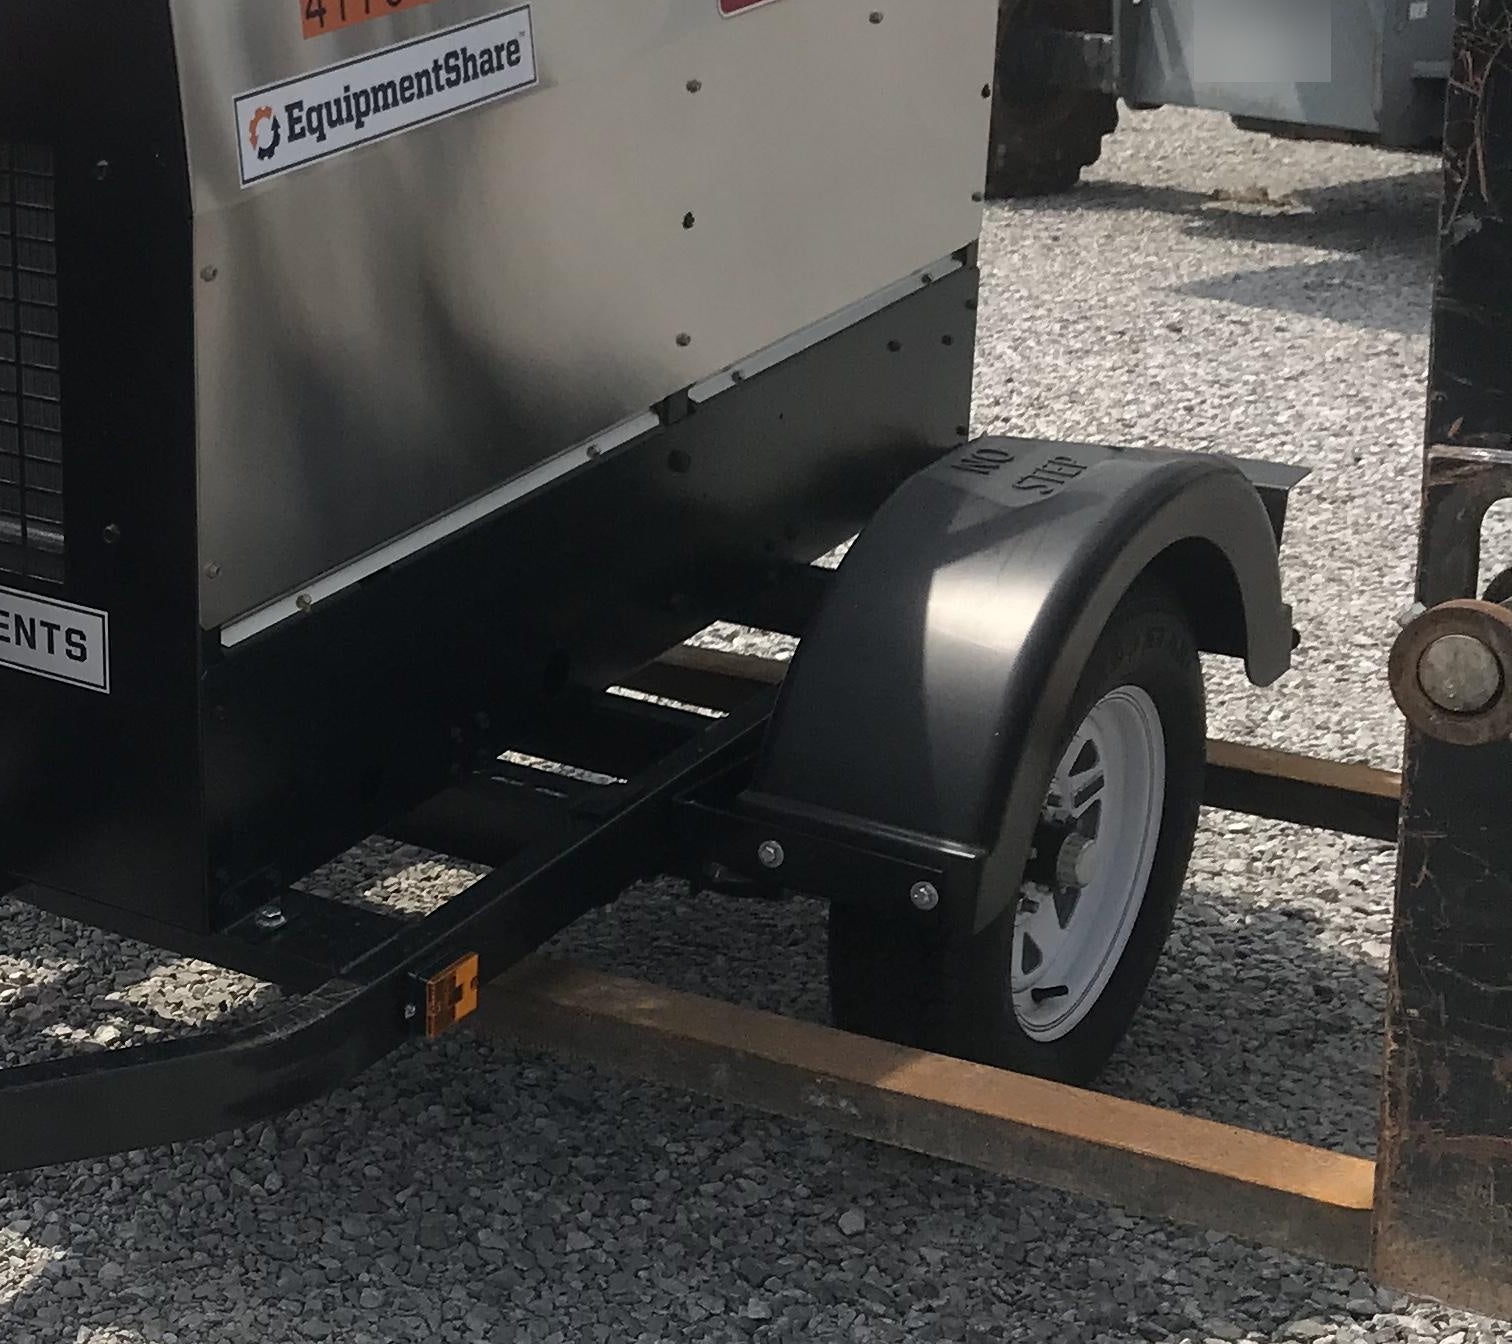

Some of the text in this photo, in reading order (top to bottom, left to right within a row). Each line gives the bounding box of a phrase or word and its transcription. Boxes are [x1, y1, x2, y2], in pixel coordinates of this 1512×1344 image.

[285, 38, 521, 143] EquipmentShare
[950, 448, 1015, 475] NO
[1011, 456, 1088, 495] STEP
